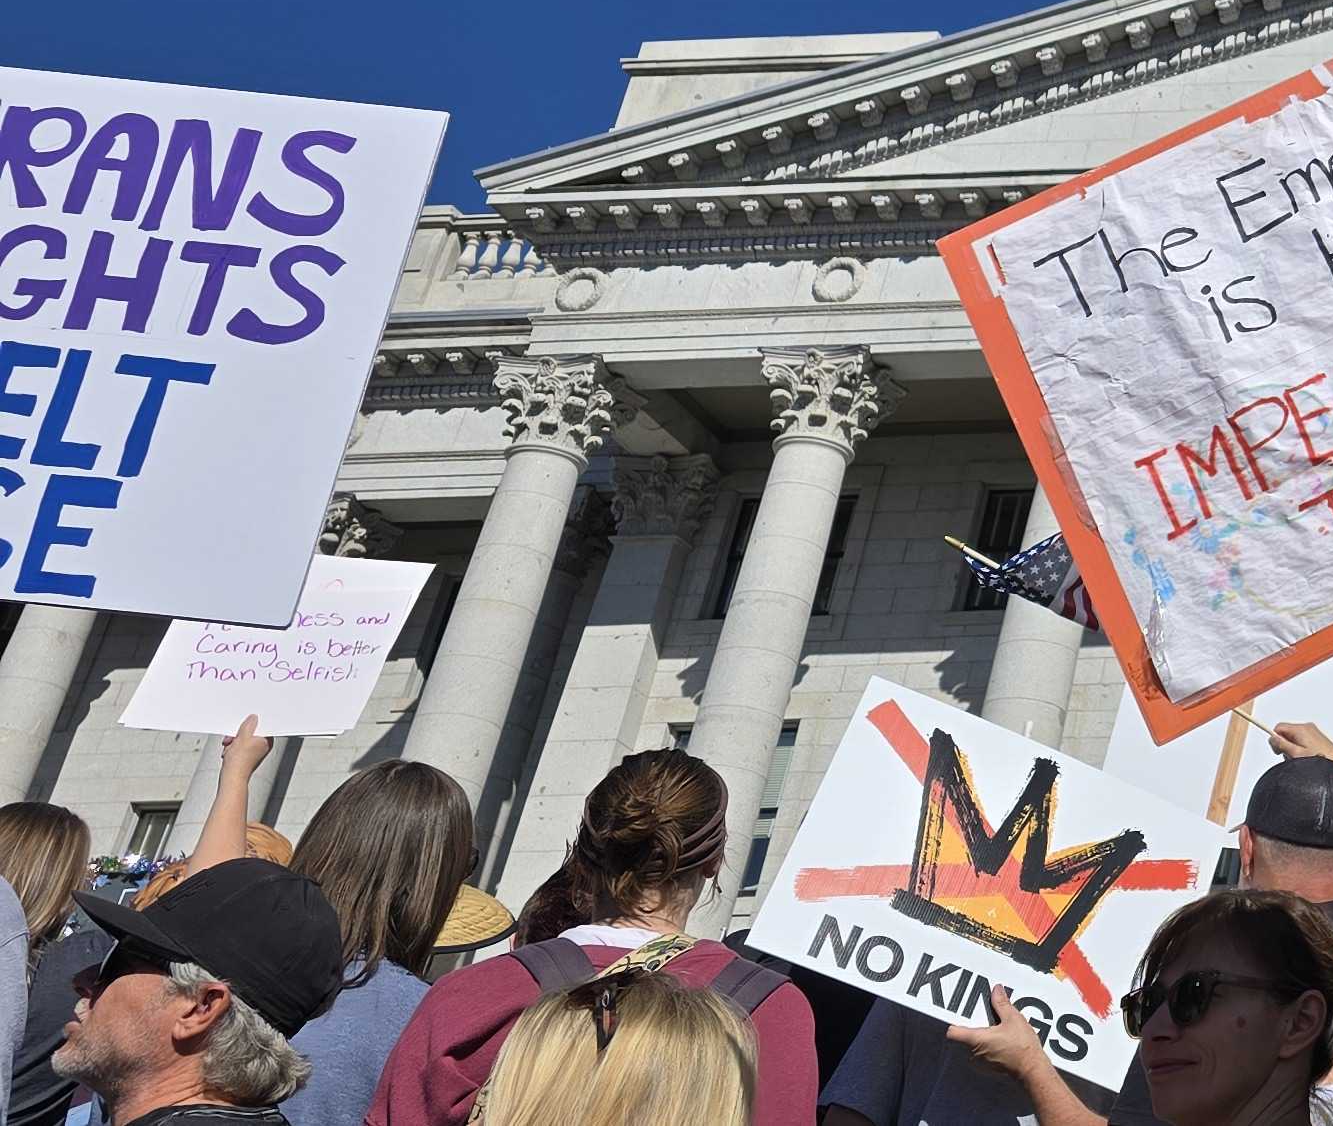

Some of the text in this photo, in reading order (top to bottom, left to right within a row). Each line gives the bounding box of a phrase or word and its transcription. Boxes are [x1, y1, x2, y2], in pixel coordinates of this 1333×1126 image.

[0, 106, 356, 236] RANS
[1034, 224, 1211, 318] The
[1205, 270, 1278, 344] is
[195, 634, 381, 667] Caring is better
[356, 612, 389, 624] and
[187, 661, 256, 681] Than
[807, 913, 1094, 1062] NO KINGS
